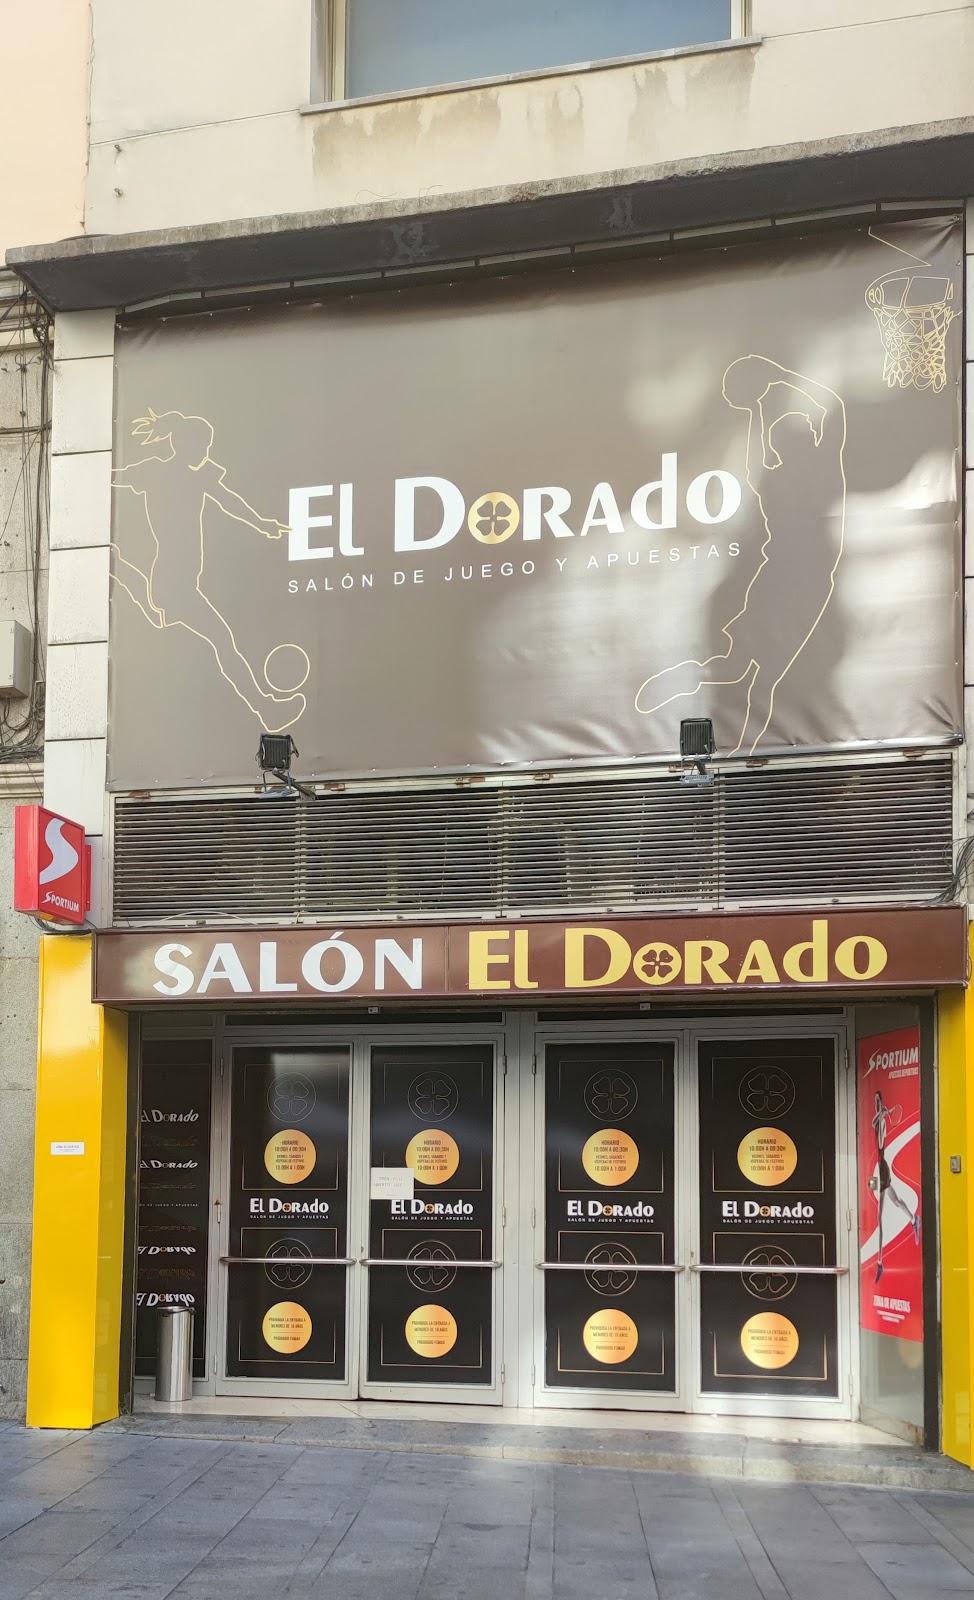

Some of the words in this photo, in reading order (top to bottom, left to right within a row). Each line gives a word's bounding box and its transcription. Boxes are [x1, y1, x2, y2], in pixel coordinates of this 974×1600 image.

[288, 573, 373, 593] SALÓN
[394, 570, 424, 585] DE
[444, 561, 534, 581] JUEGO
[555, 558, 567, 571] Y
[587, 542, 740, 569] APUESTAS
[41, 891, 79, 912] SPORTIUM
[152, 931, 422, 996] SALÓN
[862, 1047, 918, 1079] SPORTIUM
